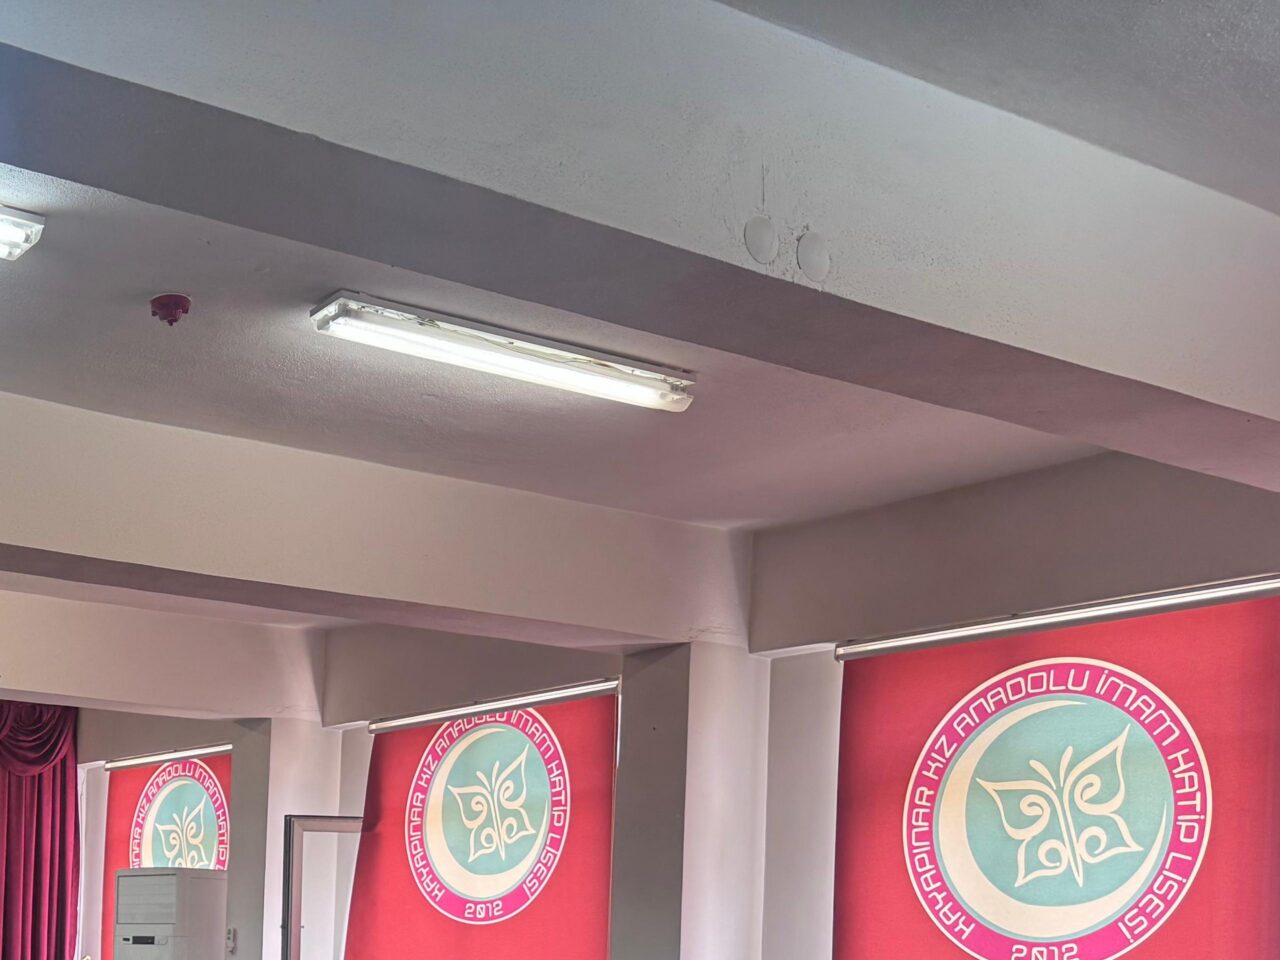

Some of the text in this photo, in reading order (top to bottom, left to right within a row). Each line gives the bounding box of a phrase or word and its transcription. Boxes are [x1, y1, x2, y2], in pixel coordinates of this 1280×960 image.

[953, 668, 1089, 738] ANADOLU
[418, 753, 439, 787] KIZ
[922, 734, 957, 780] KIZ
[147, 763, 195, 800] ANADOLU
[409, 792, 446, 902] KAYAPINAR
[910, 785, 976, 941] KAYAPINAR
[464, 900, 504, 918] 2012
